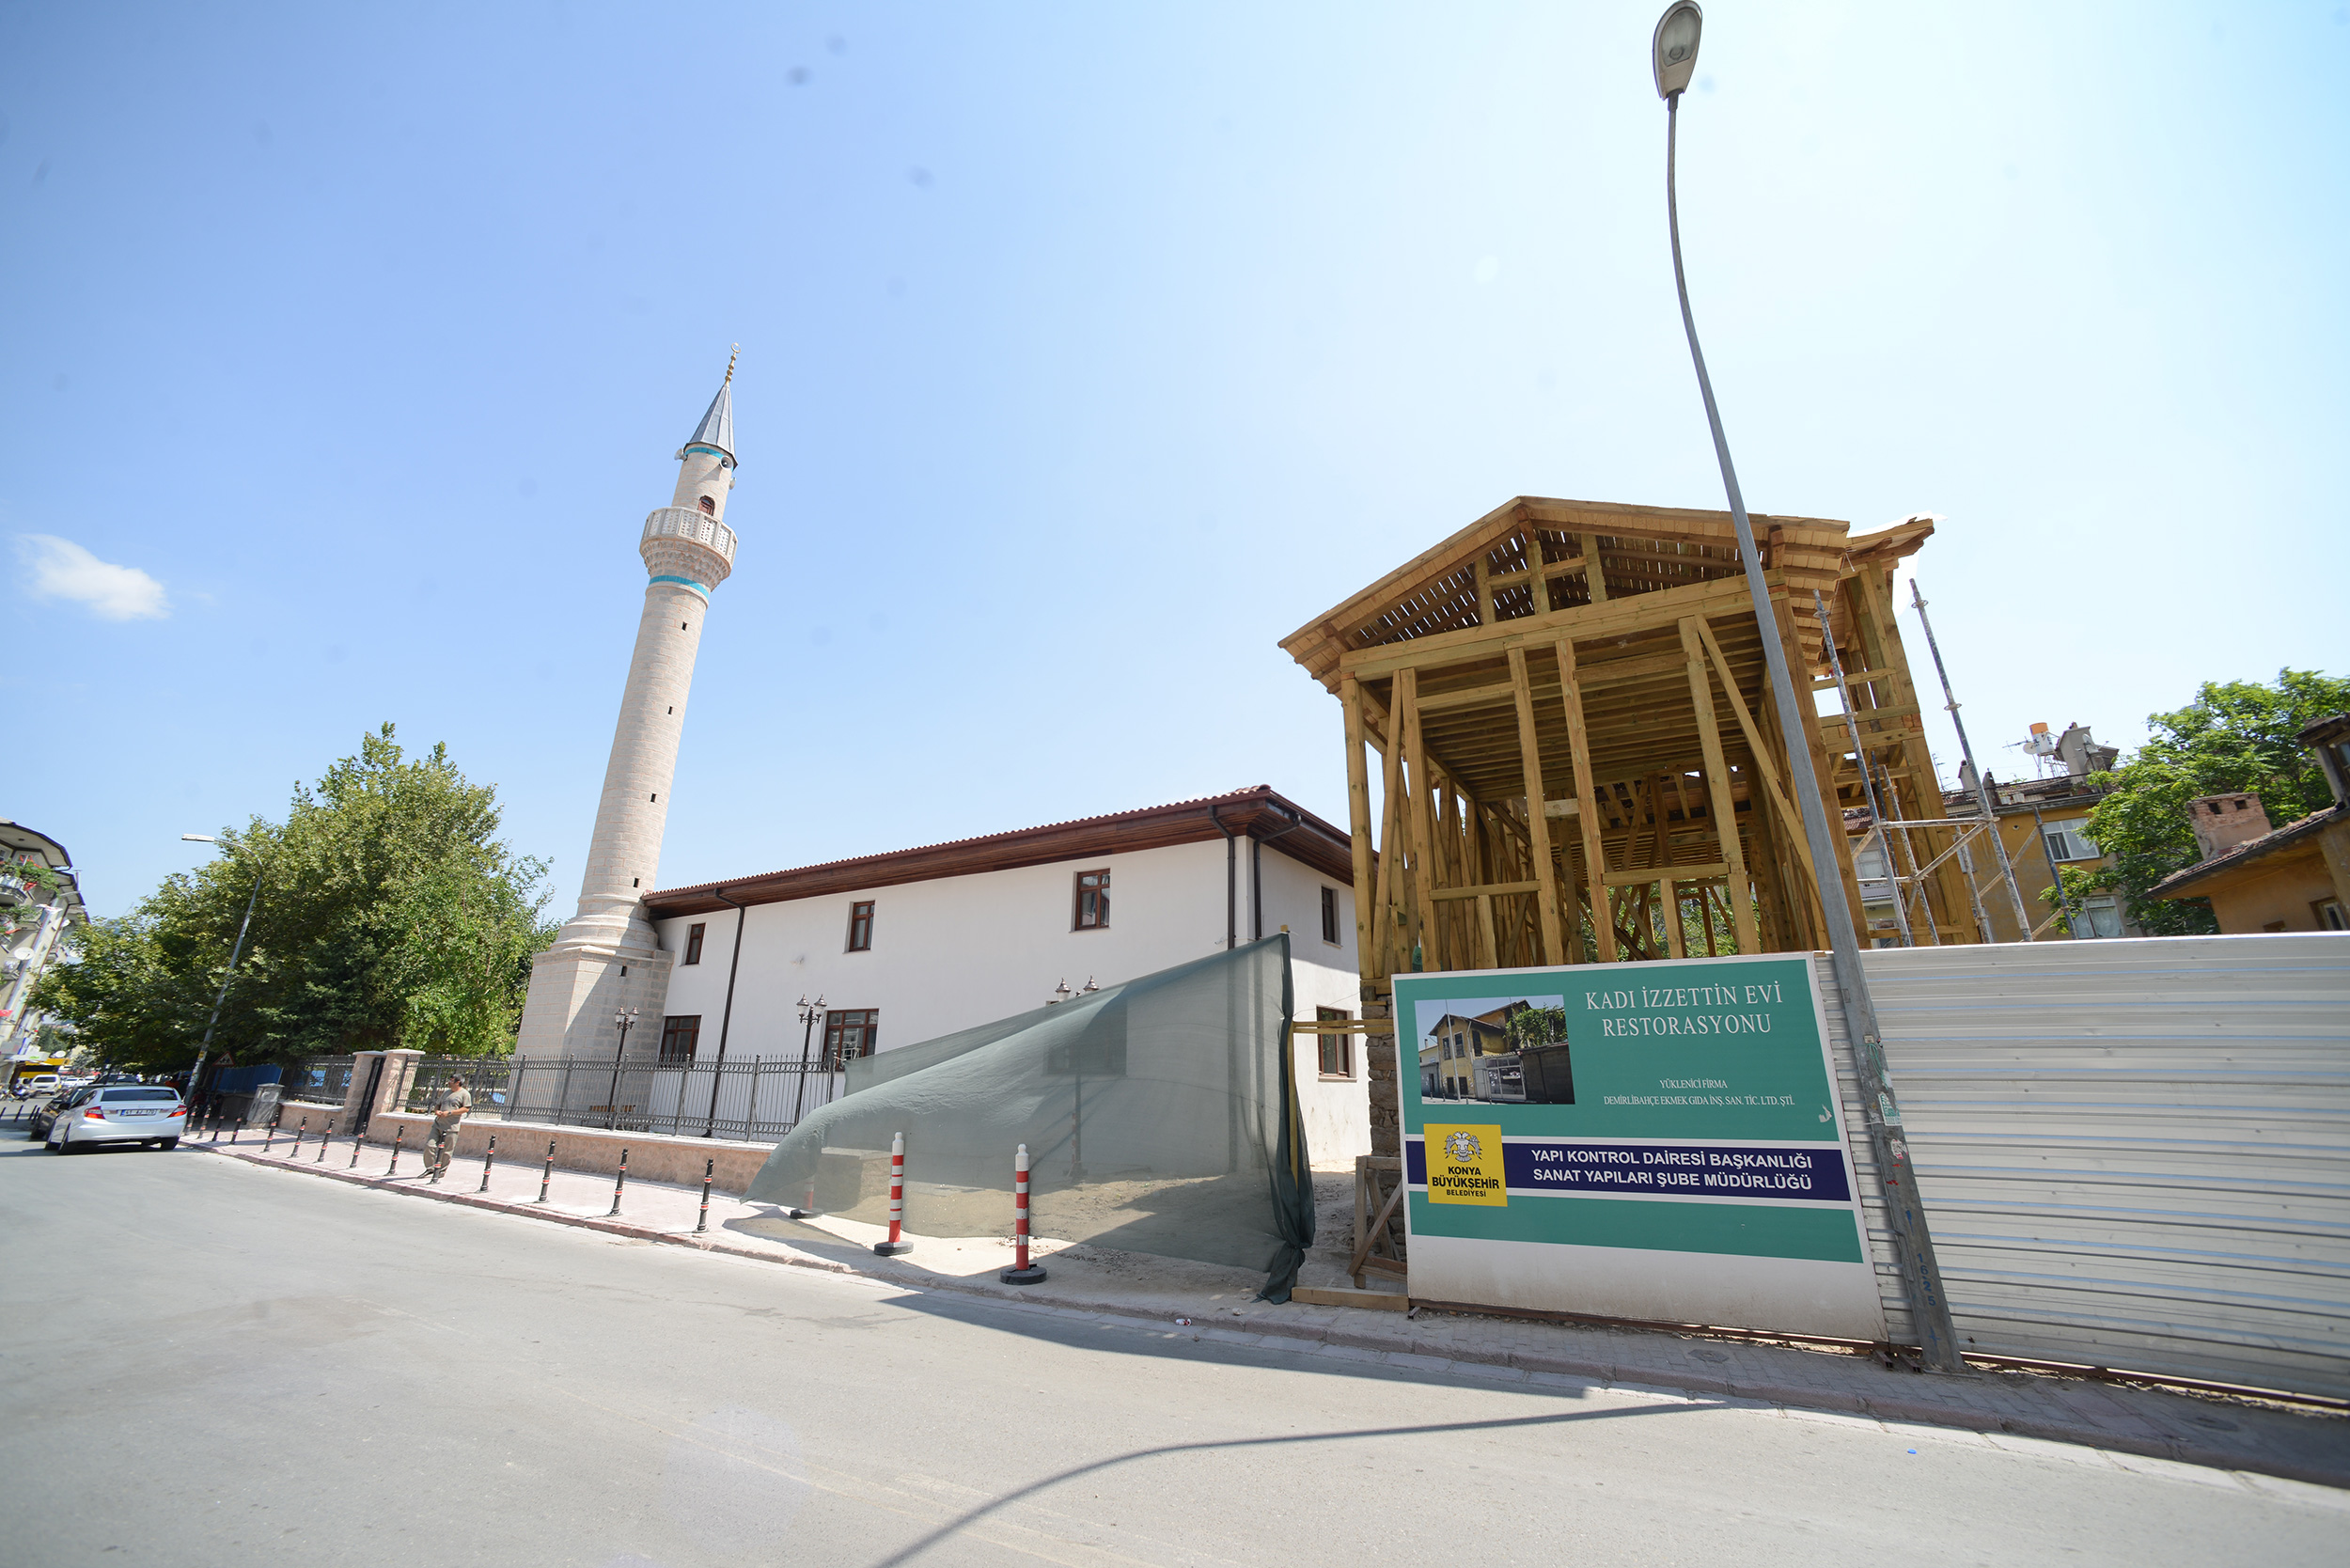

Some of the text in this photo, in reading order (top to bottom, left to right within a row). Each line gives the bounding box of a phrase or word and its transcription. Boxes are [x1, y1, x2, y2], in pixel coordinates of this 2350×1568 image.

[1585, 980, 1783, 1010] KADI İZZETTİN EVİ
[1602, 1013, 1772, 1037] RESTORASYONU
[1660, 1078, 1728, 1089] YÜKLENİCİ FİRMA
[1604, 1094, 1659, 1106] DEMİRLİBAHÇE
[1661, 1096, 1688, 1105] EKMEK
[1688, 1096, 1709, 1105] GIDA
[1761, 1095, 1779, 1105] LTD.
[1531, 1150, 1813, 1169] YAPI KONTROL DAİRESİ BAŞKANLIĞI
[1448, 1167, 1481, 1175] KONYA
[1533, 1168, 1812, 1190] SANAT YAPILARI ŞUBE MÜDÜRLÜĞÜ
[1432, 1174, 1500, 1190] BÜYÜKŞEHİR
[1447, 1189, 1487, 1198] BELEDİYESİ
